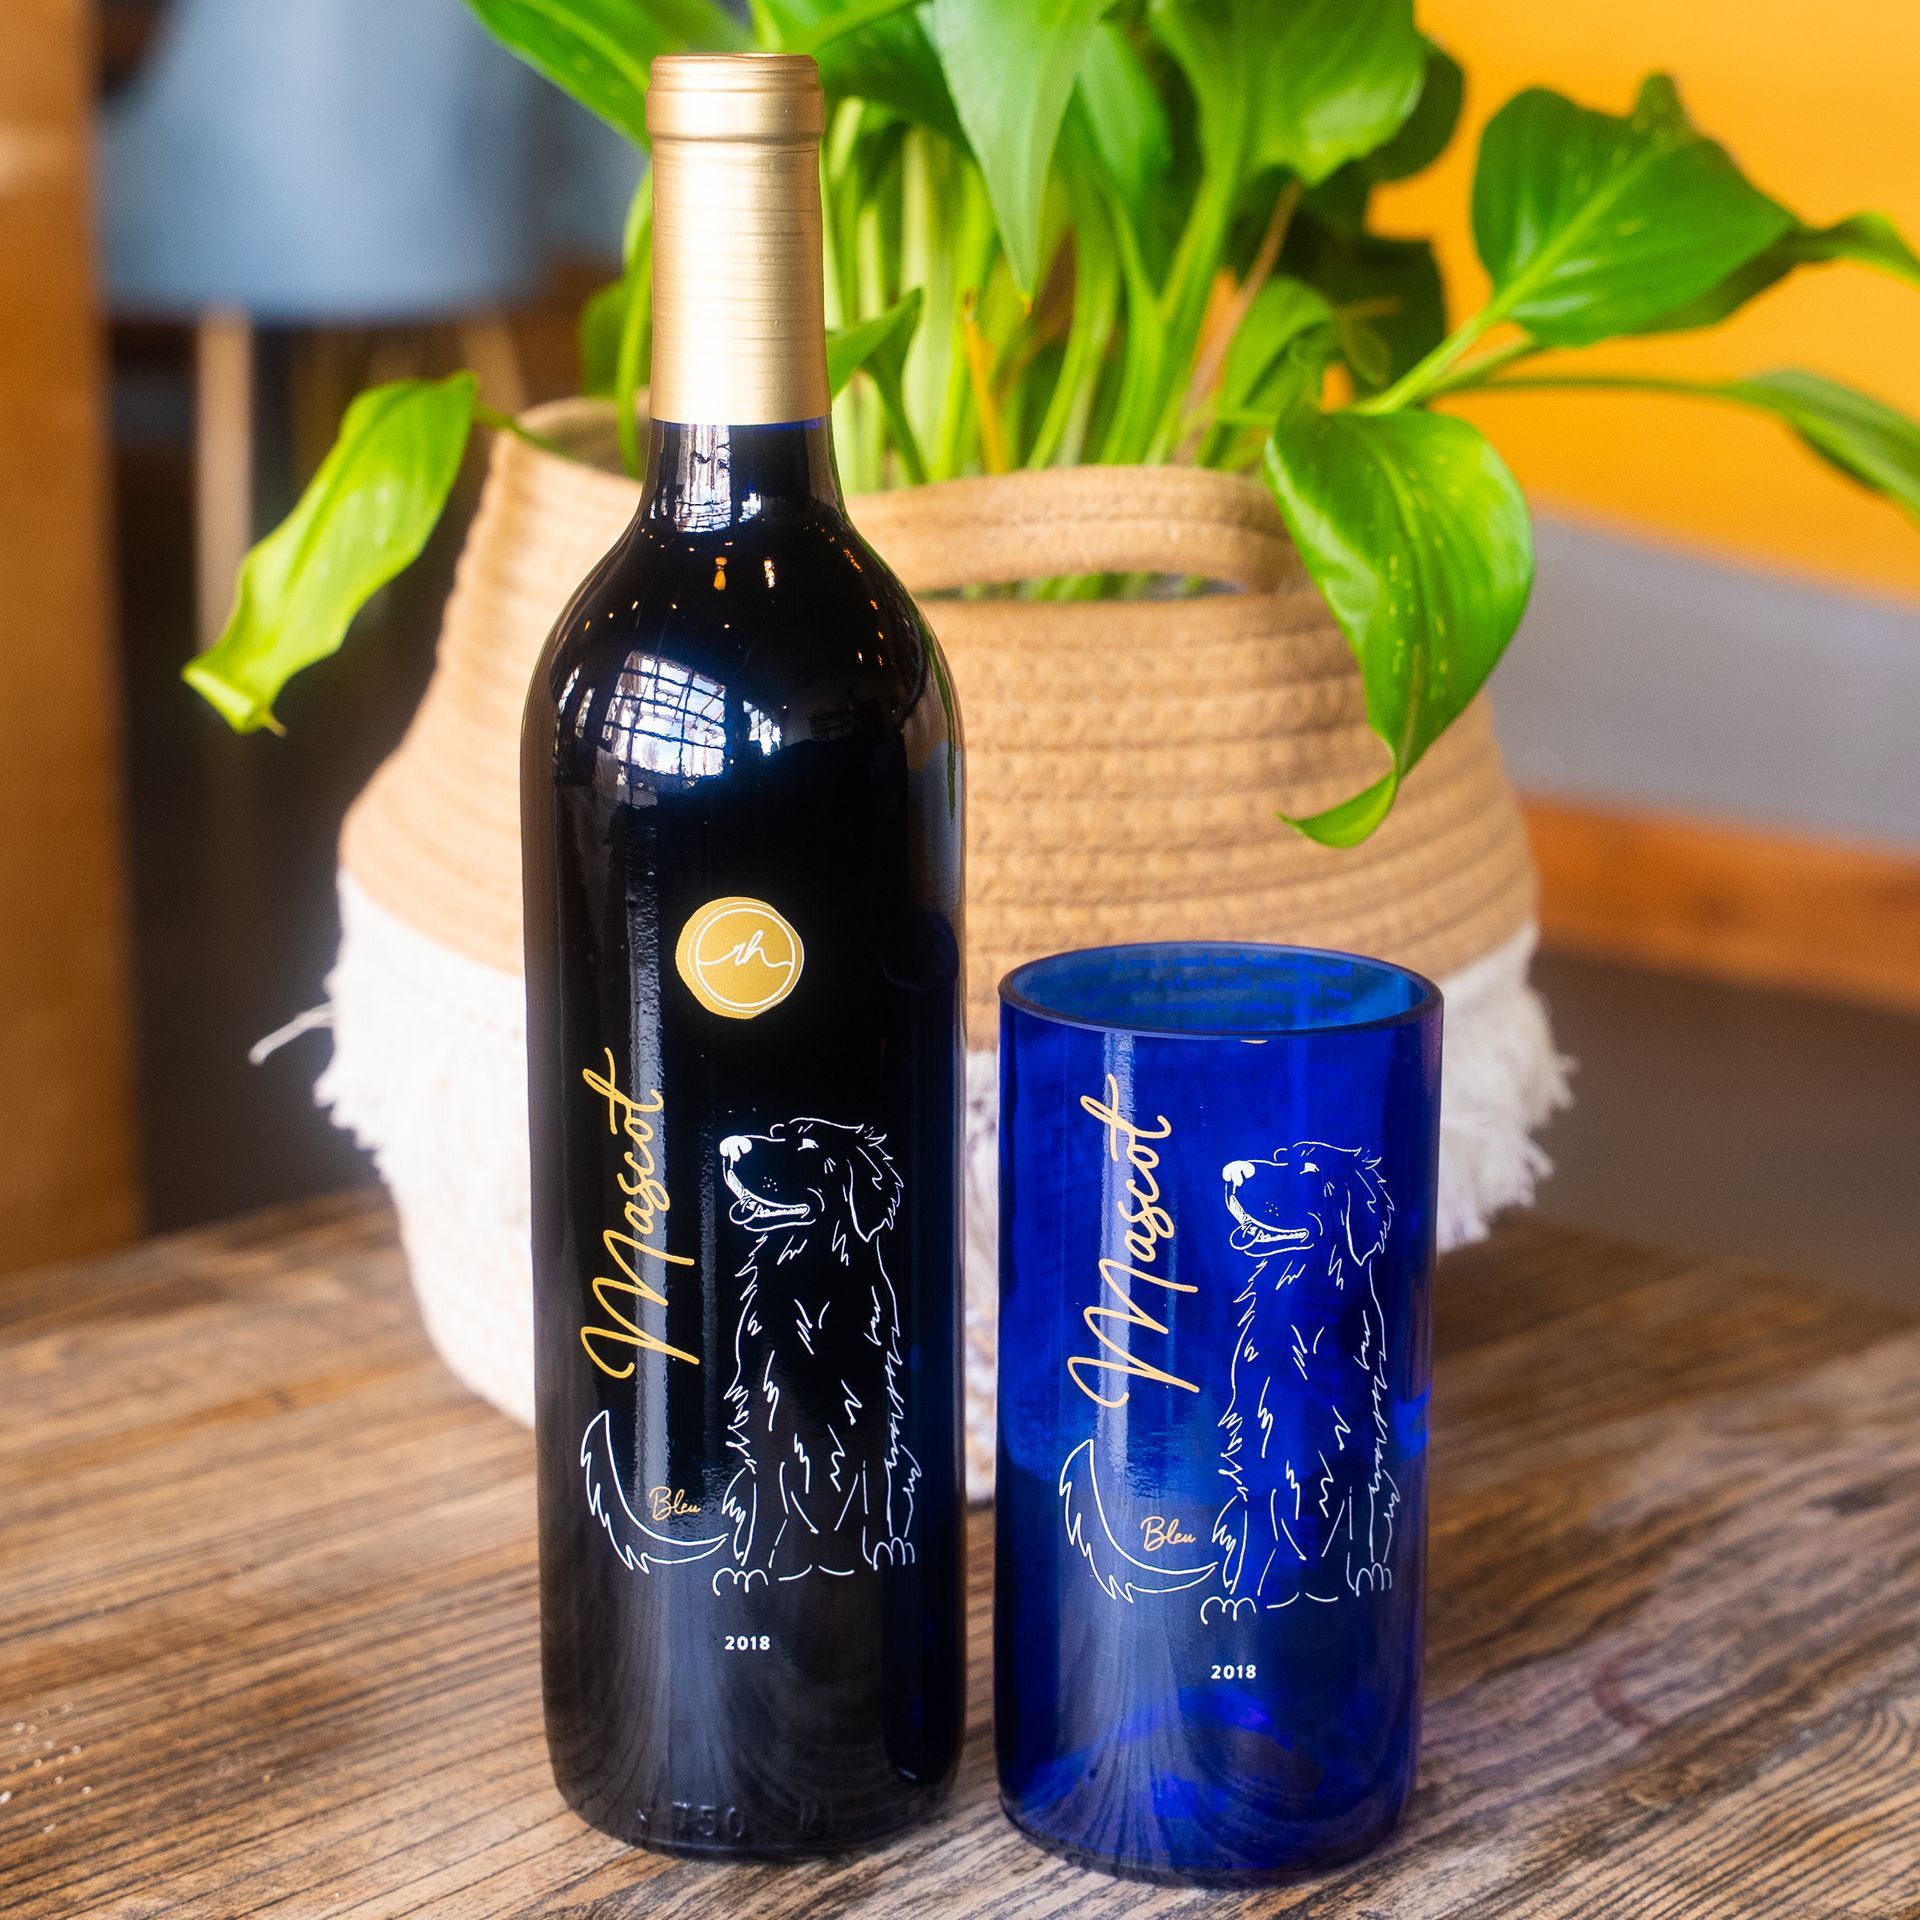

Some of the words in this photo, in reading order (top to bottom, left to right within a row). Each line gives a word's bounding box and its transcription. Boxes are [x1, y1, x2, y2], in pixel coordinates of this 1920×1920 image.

[580, 1047, 700, 1379] Mascot
[1067, 1073, 1200, 1409] Mascot
[649, 1485, 702, 1521] Bleu
[1140, 1516, 1197, 1551] Bleu
[724, 1635, 771, 1651] 2018
[1210, 1664, 1257, 1680] 2018
